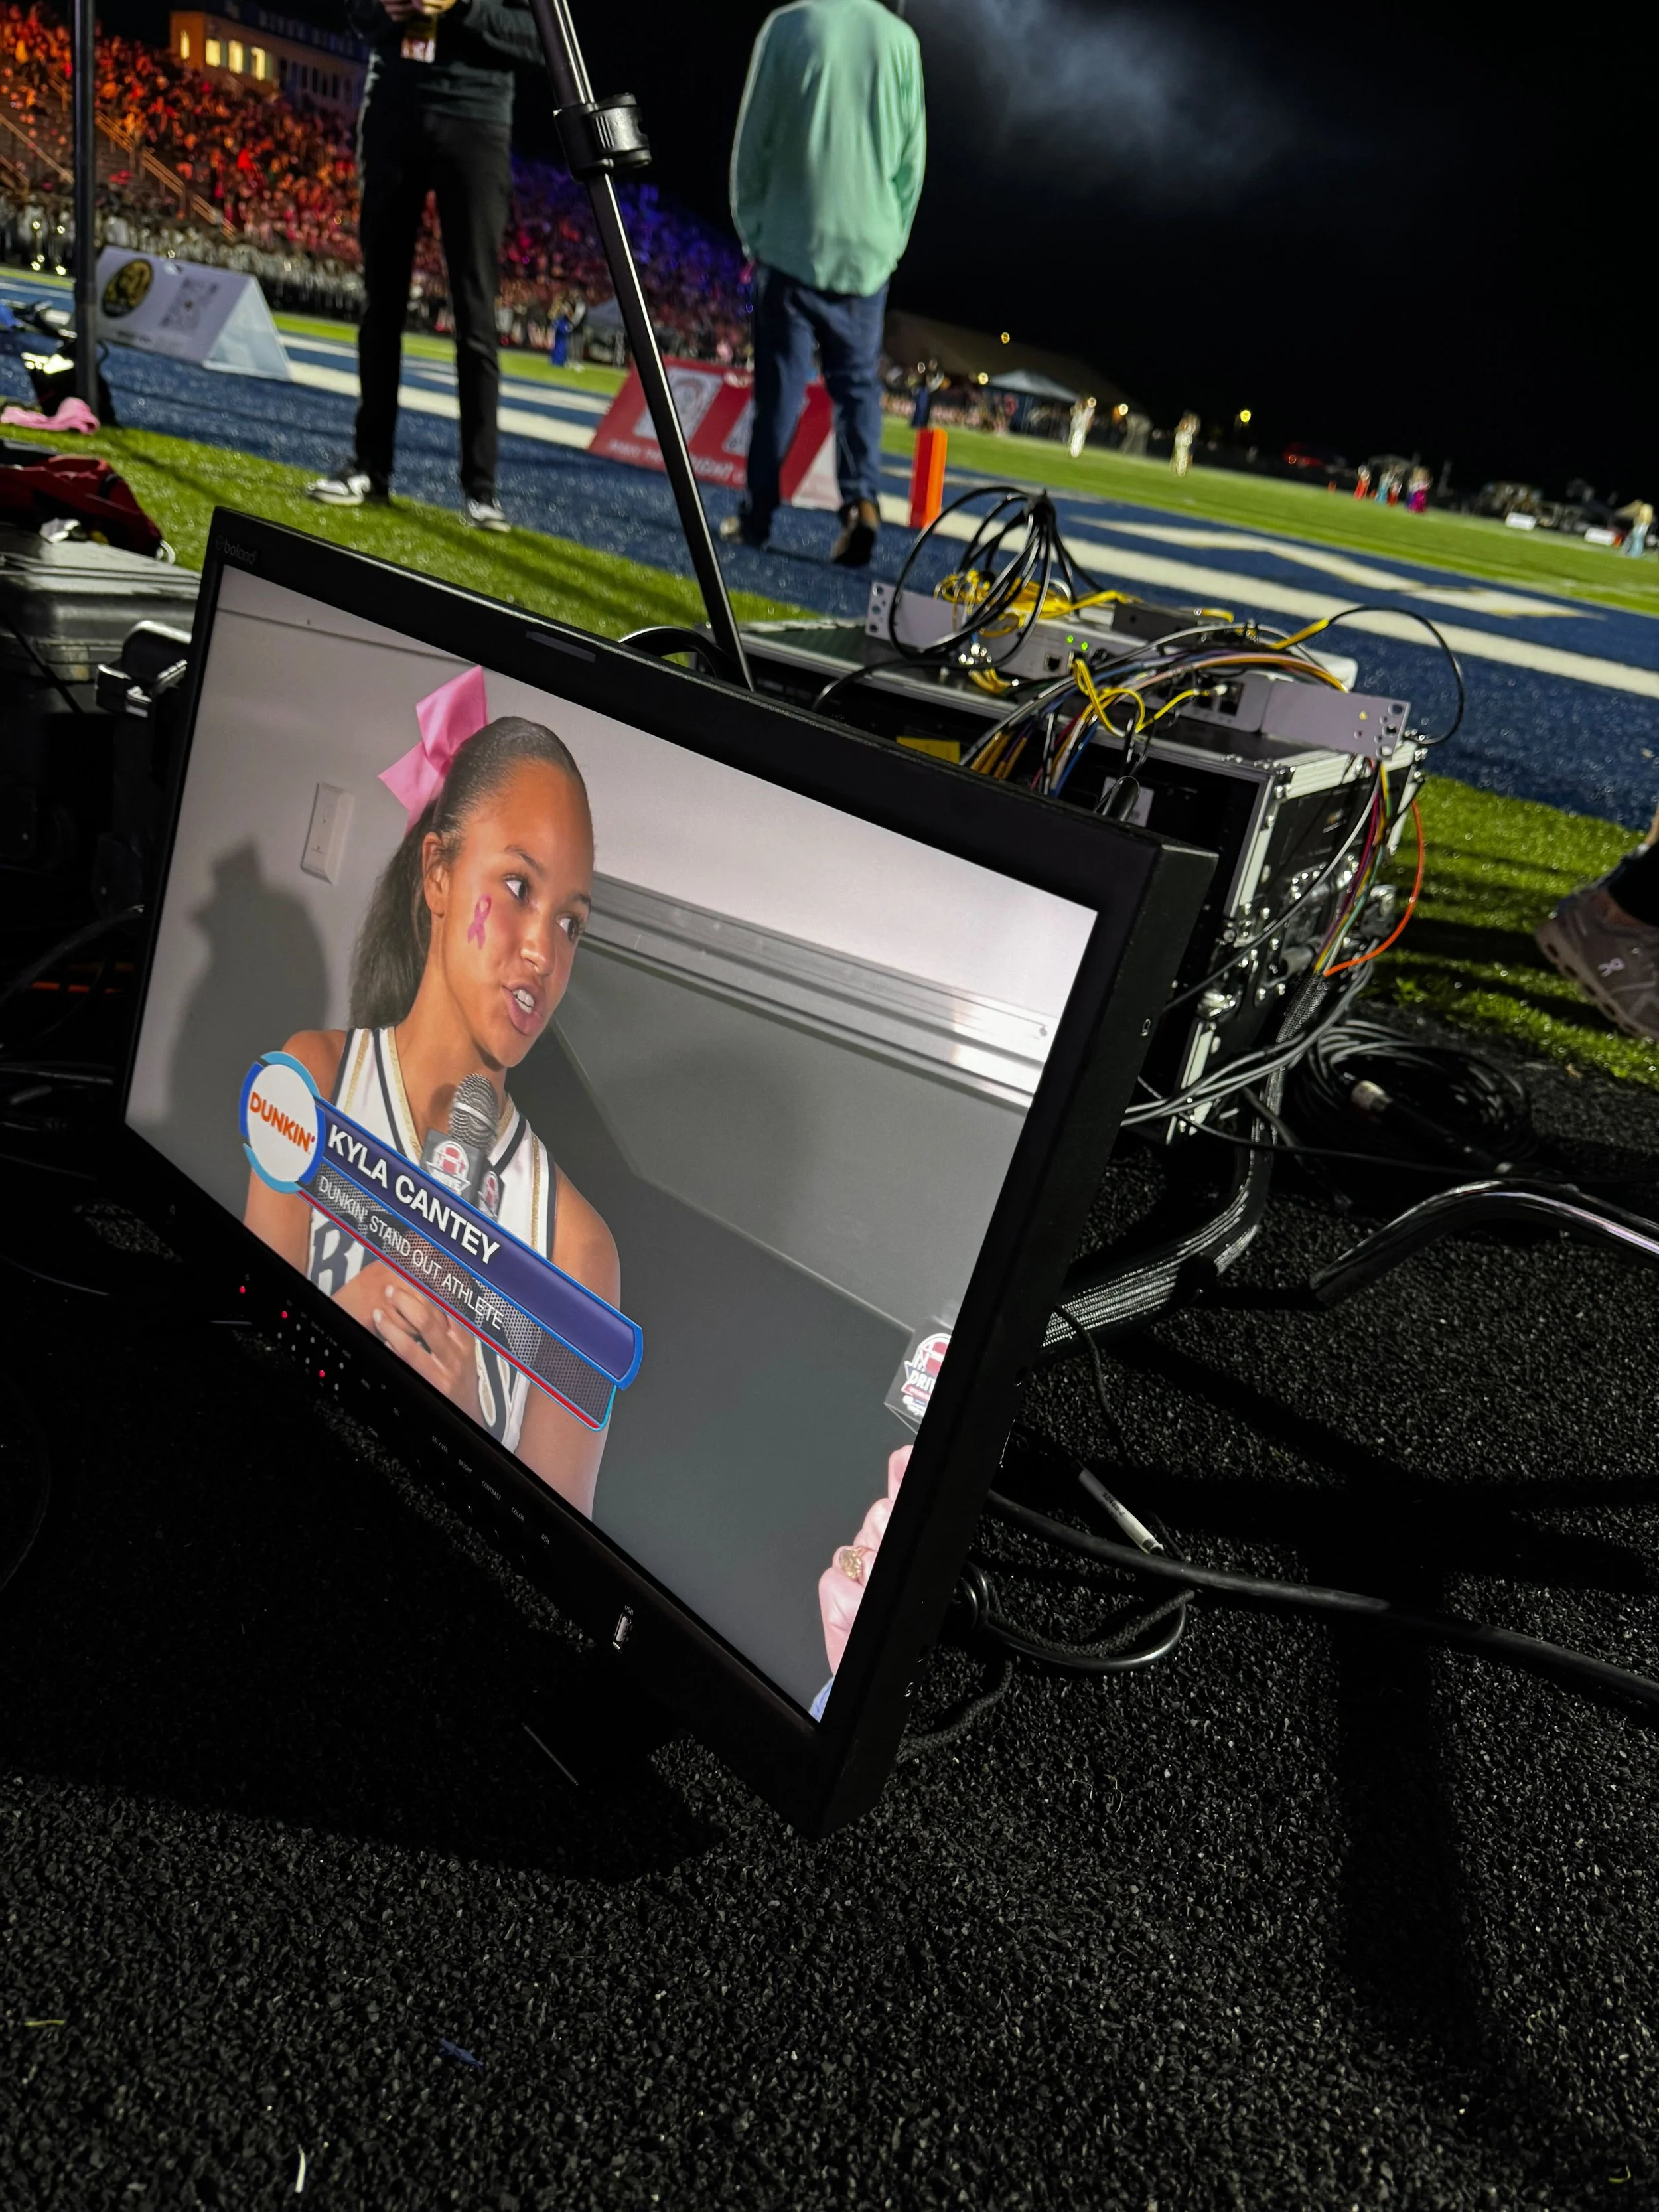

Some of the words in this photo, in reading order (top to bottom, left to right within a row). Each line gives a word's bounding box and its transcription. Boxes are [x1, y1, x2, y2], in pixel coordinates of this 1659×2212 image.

[224, 536, 257, 565] boland
[250, 1092, 315, 1152] DUNKIN'
[328, 1124, 388, 1189] KYLA
[395, 1175, 500, 1264] CANTEY
[319, 1175, 368, 1223] DUNKIN'
[369, 1215, 410, 1256] STAND
[413, 1249, 442, 1280] OUT
[442, 1273, 504, 1330] ATHLETE
[458, 1459, 472, 1474] BRIGHT
[482, 1480, 502, 1501] CONTRAST
[511, 1507, 525, 1523] COLOR
[541, 1534, 550, 1545] DIM
[624, 1603, 634, 1616] USB
